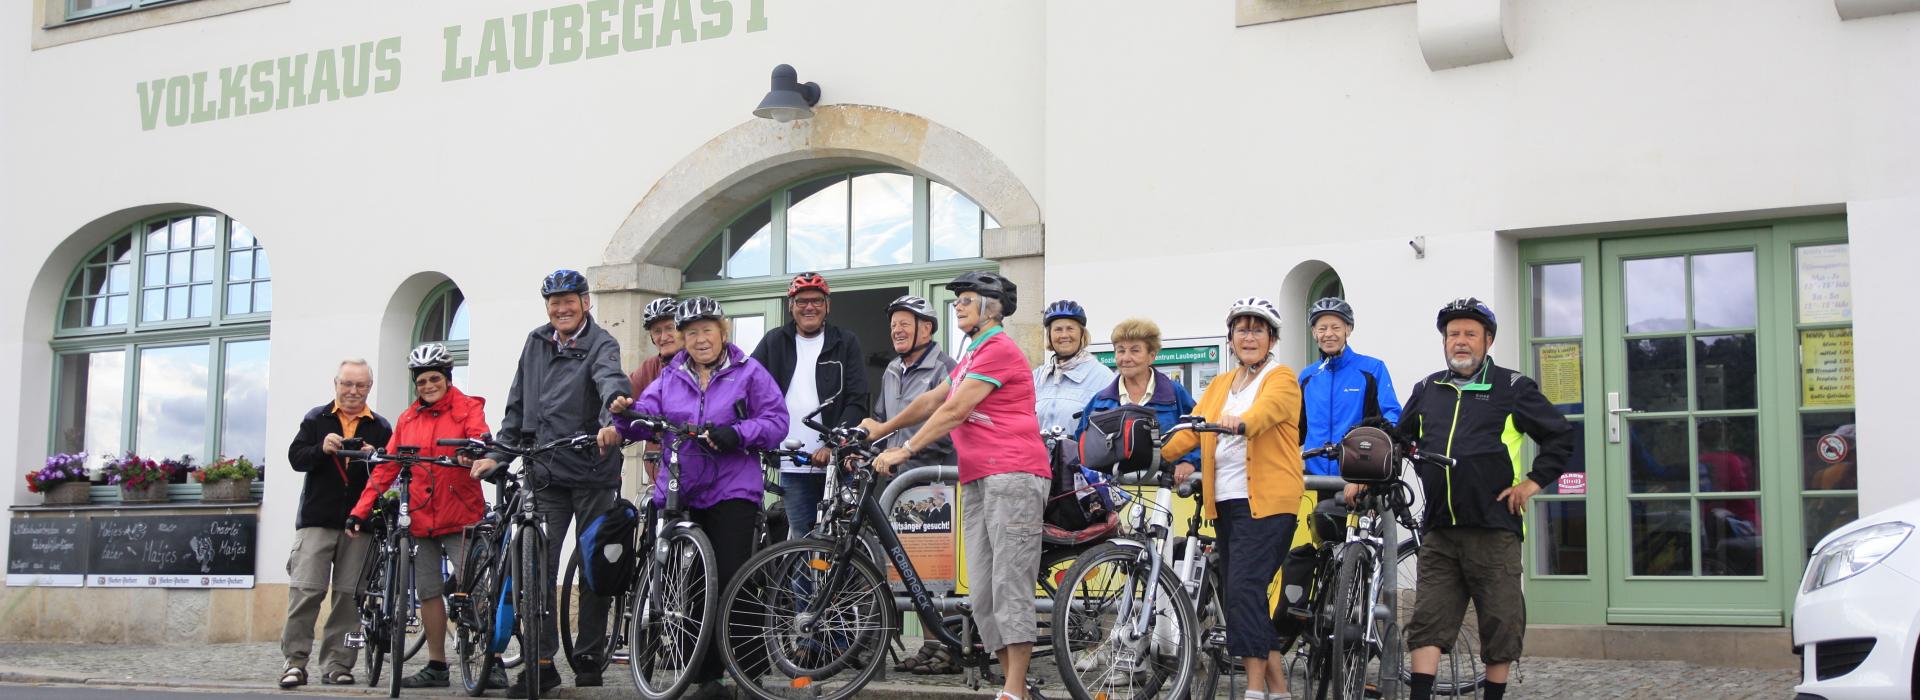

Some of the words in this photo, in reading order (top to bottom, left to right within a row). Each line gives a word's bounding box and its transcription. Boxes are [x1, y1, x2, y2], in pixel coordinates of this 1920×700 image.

[136, 36, 401, 131] VOLKSHAUS
[1175, 351, 1206, 360] Laubegast
[923, 521, 950, 532] gesucht!
[142, 539, 177, 569] Matjes
[219, 540, 247, 561] Matjes
